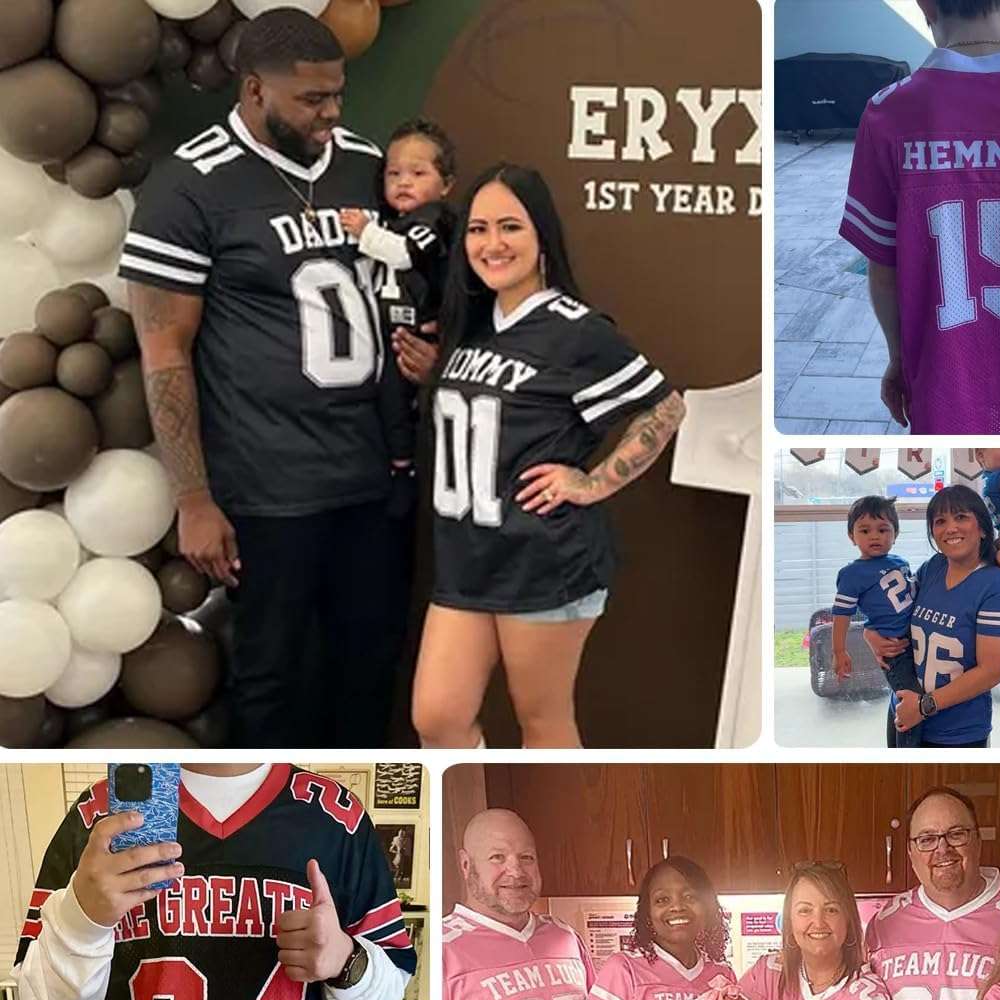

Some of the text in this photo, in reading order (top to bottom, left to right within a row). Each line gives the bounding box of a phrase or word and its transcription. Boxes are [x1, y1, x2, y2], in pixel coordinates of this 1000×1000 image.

[584, 180, 640, 211] 1ST
[650, 183, 736, 215] YEAR
[269, 207, 380, 254] DAD
[433, 387, 503, 528] 01
[480, 965, 546, 1000] TEAM
[882, 952, 942, 981] TEAM
